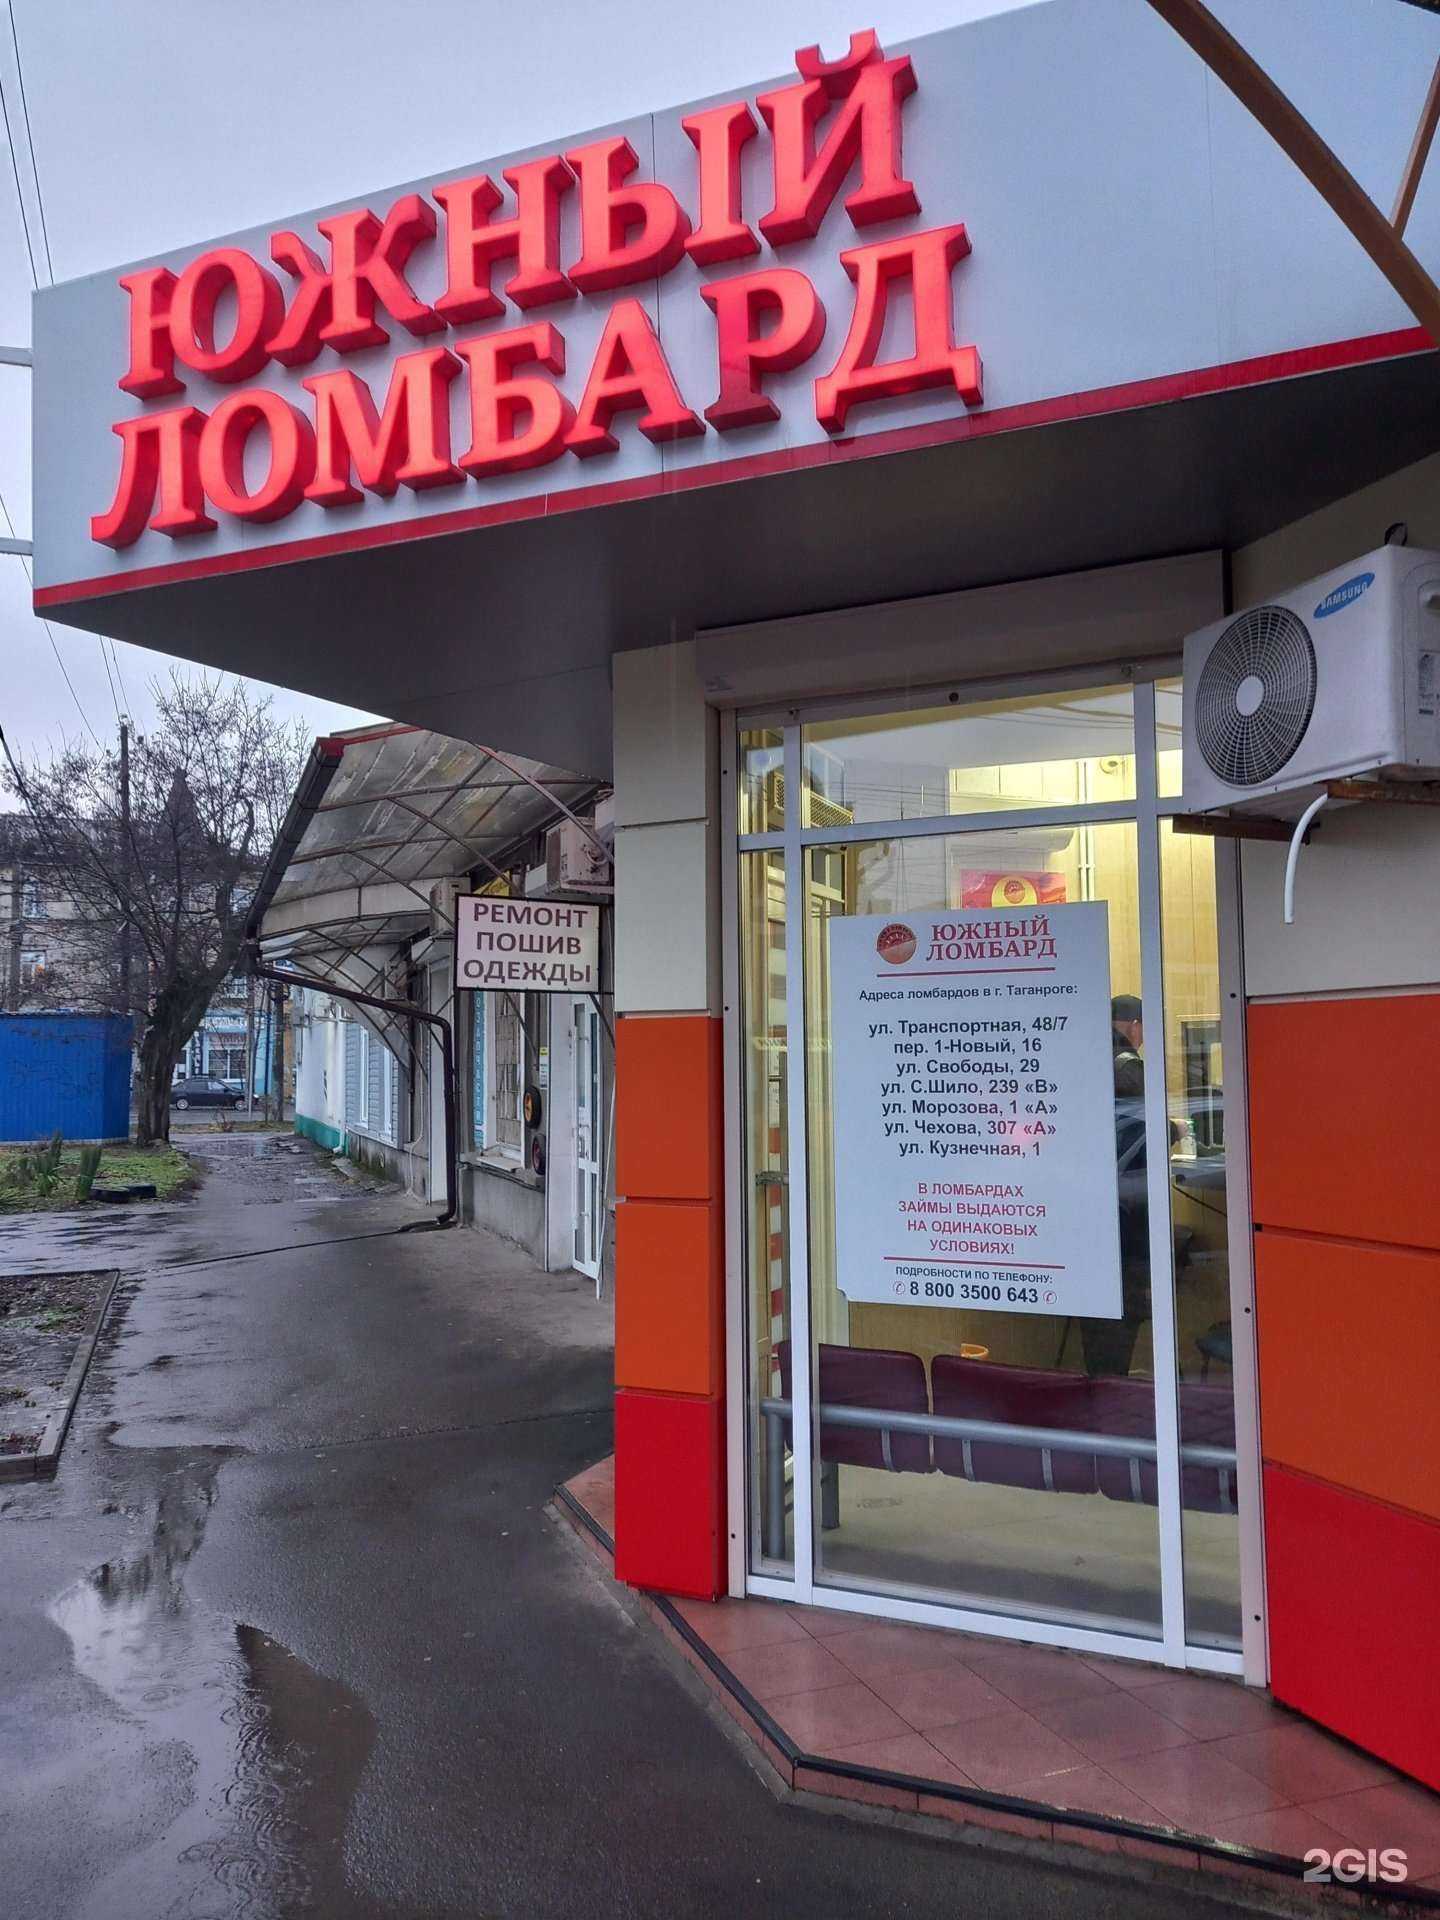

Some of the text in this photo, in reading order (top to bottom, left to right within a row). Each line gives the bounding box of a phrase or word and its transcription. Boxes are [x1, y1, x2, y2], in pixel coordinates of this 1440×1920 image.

[119, 28, 922, 400] ЮЖНЫЙ
[90, 222, 984, 551] ЛОМБАРД
[1321, 582, 1368, 609] SAMSUNG
[473, 903, 588, 928] РЕМОНТ
[931, 915, 1050, 942] ЮЖНЫЙ
[476, 932, 582, 955] ПОШИВ
[926, 938, 1058, 962] ЛОМБАРД
[463, 959, 591, 986] ОДЕЖДЫ
[859, 984, 1078, 1002] Адреса ломбардов в г. Таганроге:
[868, 1016, 1069, 1038] ул. Транспортная, 48/7
[894, 1038, 1042, 1057] пер. 1-Новый, 16
[896, 1058, 1040, 1077] ул. Свободы, 29
[881, 1079, 1058, 1097] ул. С.Шило, 239 «В»
[881, 1100, 1058, 1117] ул. Морозова, 1 «А»
[884, 1120, 1057, 1137] ул. Чехова, 307 «А»
[899, 1140, 1040, 1158] ул. Кузнечная, 1
[918, 1182, 1024, 1199] В ЛОМБАРДАХ
[898, 1199, 1046, 1218] ЗАЙМЫ ВЫДАЮТСЯ
[907, 1220, 1038, 1237] НА ОДИНАКОВЫХ
[930, 1240, 1015, 1255] УСЛОВИЯХ!
[895, 1266, 1053, 1284] ПОДРОБНОСТИ ПО ТЕЛЕФОНУ:
[910, 1281, 1039, 1303] 8 800 3500 643
